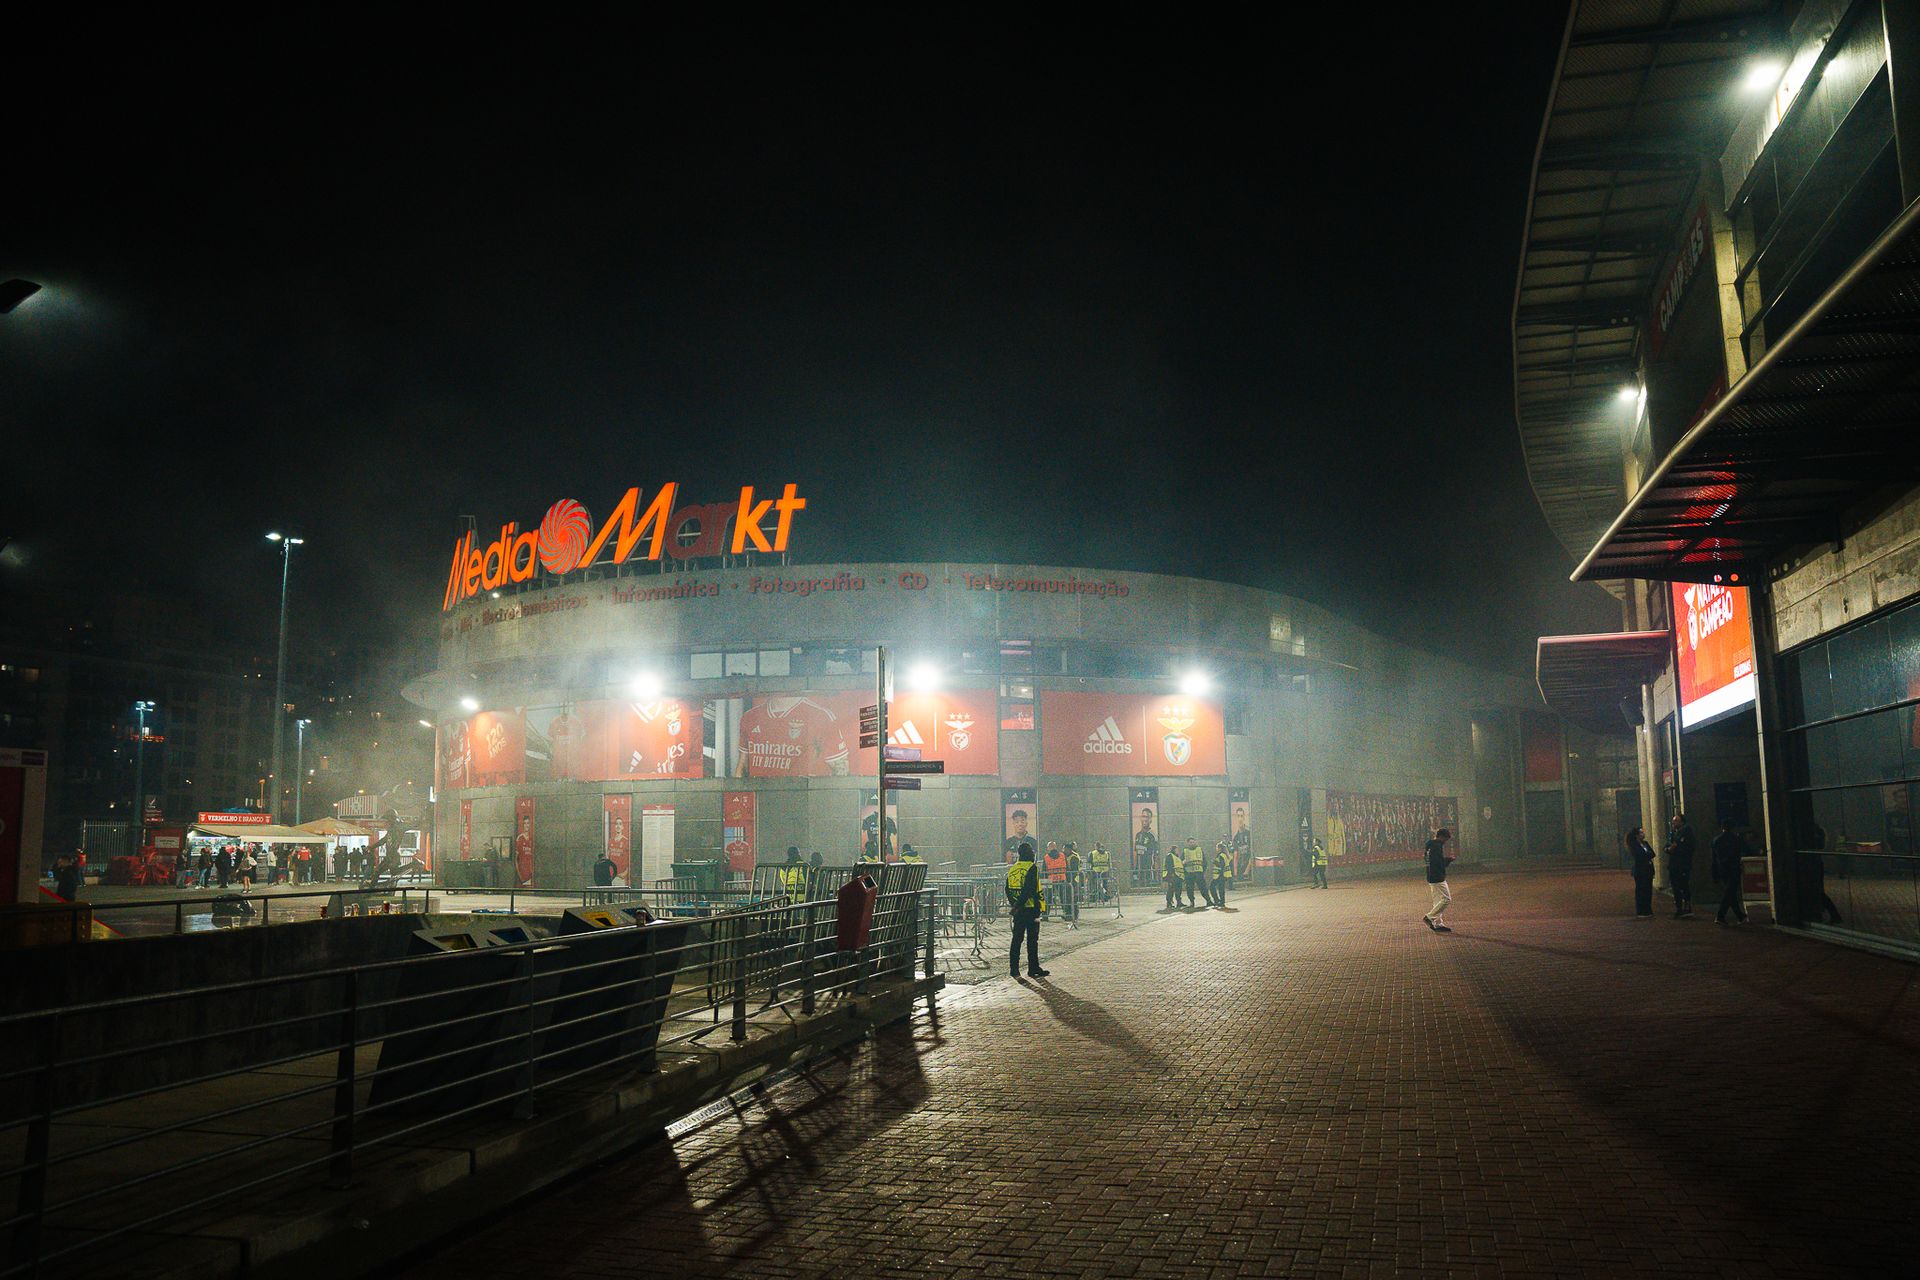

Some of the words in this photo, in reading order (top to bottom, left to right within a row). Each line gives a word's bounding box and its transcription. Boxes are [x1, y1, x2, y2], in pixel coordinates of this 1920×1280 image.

[1659, 216, 1704, 332] CAMPES
[443, 520, 541, 612] Media
[577, 482, 807, 570] Markt
[611, 577, 720, 605] Informática
[750, 573, 865, 598] Fotografia
[898, 572, 928, 591] CD
[963, 571, 1130, 600] Telecomunicação
[747, 741, 802, 757] Emirates
[1083, 740, 1132, 754] adidas
[763, 757, 792, 769] BETTER
